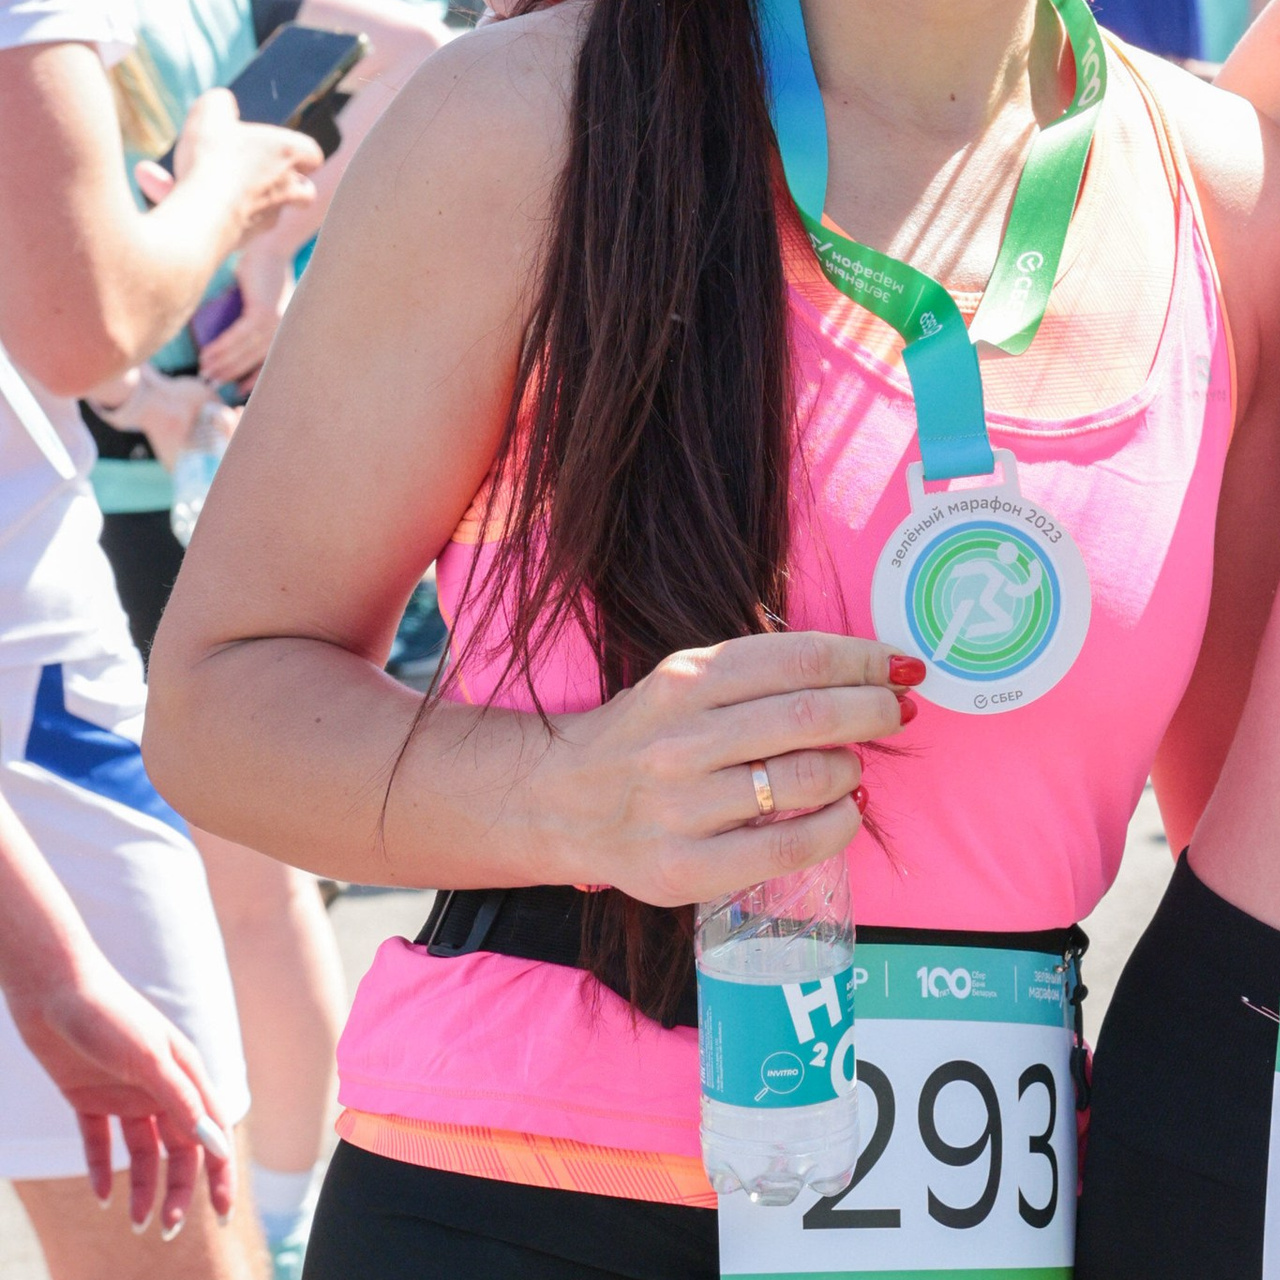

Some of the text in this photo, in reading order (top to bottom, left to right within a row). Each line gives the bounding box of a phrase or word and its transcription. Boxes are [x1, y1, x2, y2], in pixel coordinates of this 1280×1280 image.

[826, 260, 891, 303] зелёный
[832, 251, 904, 294] марафон
[892, 496, 1063, 568] зелёный марафон 2023
[991, 690, 1023, 704] СБЕР
[917, 967, 972, 999] 100
[767, 1068, 798, 1077] INVITRO
[803, 1059, 1060, 1229] 293
